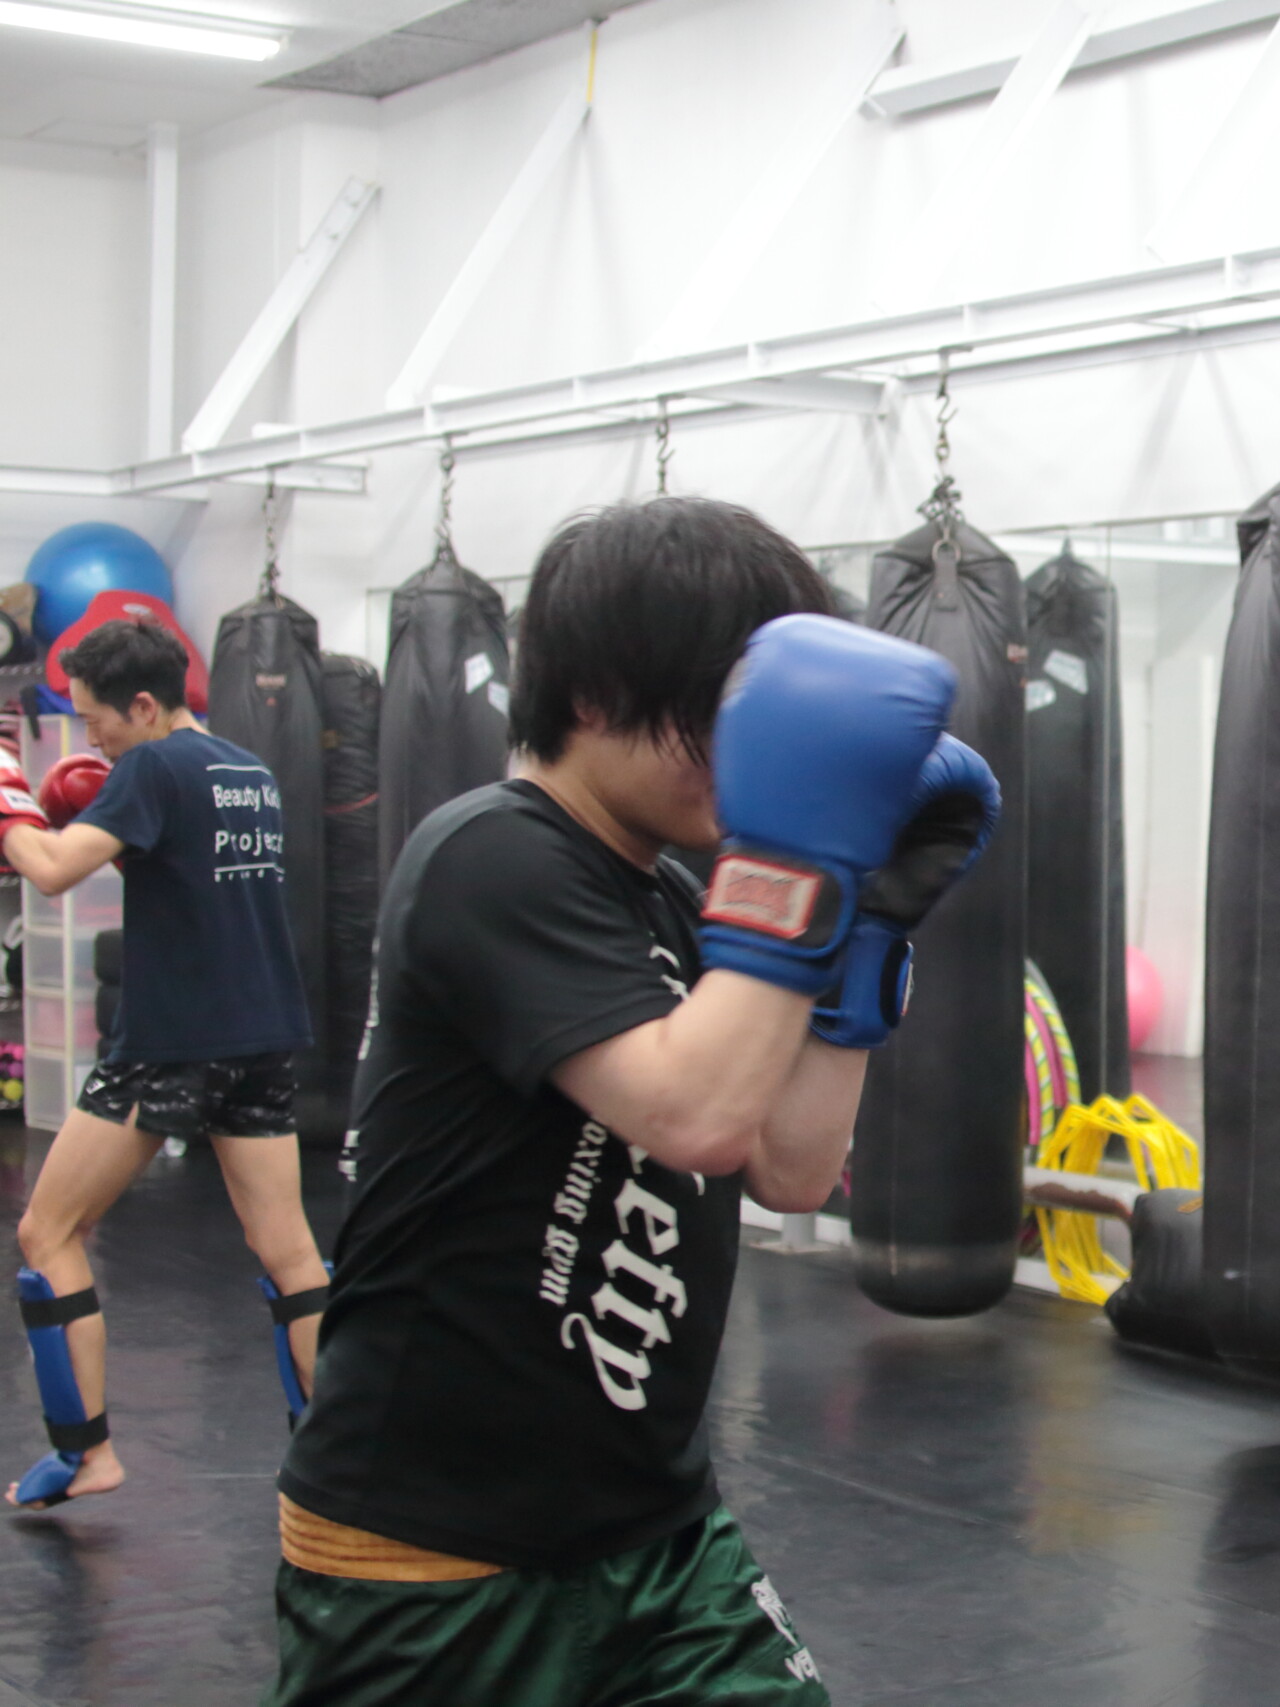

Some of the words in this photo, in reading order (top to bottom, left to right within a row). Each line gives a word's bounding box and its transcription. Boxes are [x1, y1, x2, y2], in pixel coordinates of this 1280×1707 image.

[212, 784, 261, 812] Beauty
[553, 1114, 607, 1225] oxing
[559, 1142, 705, 1412] efty
